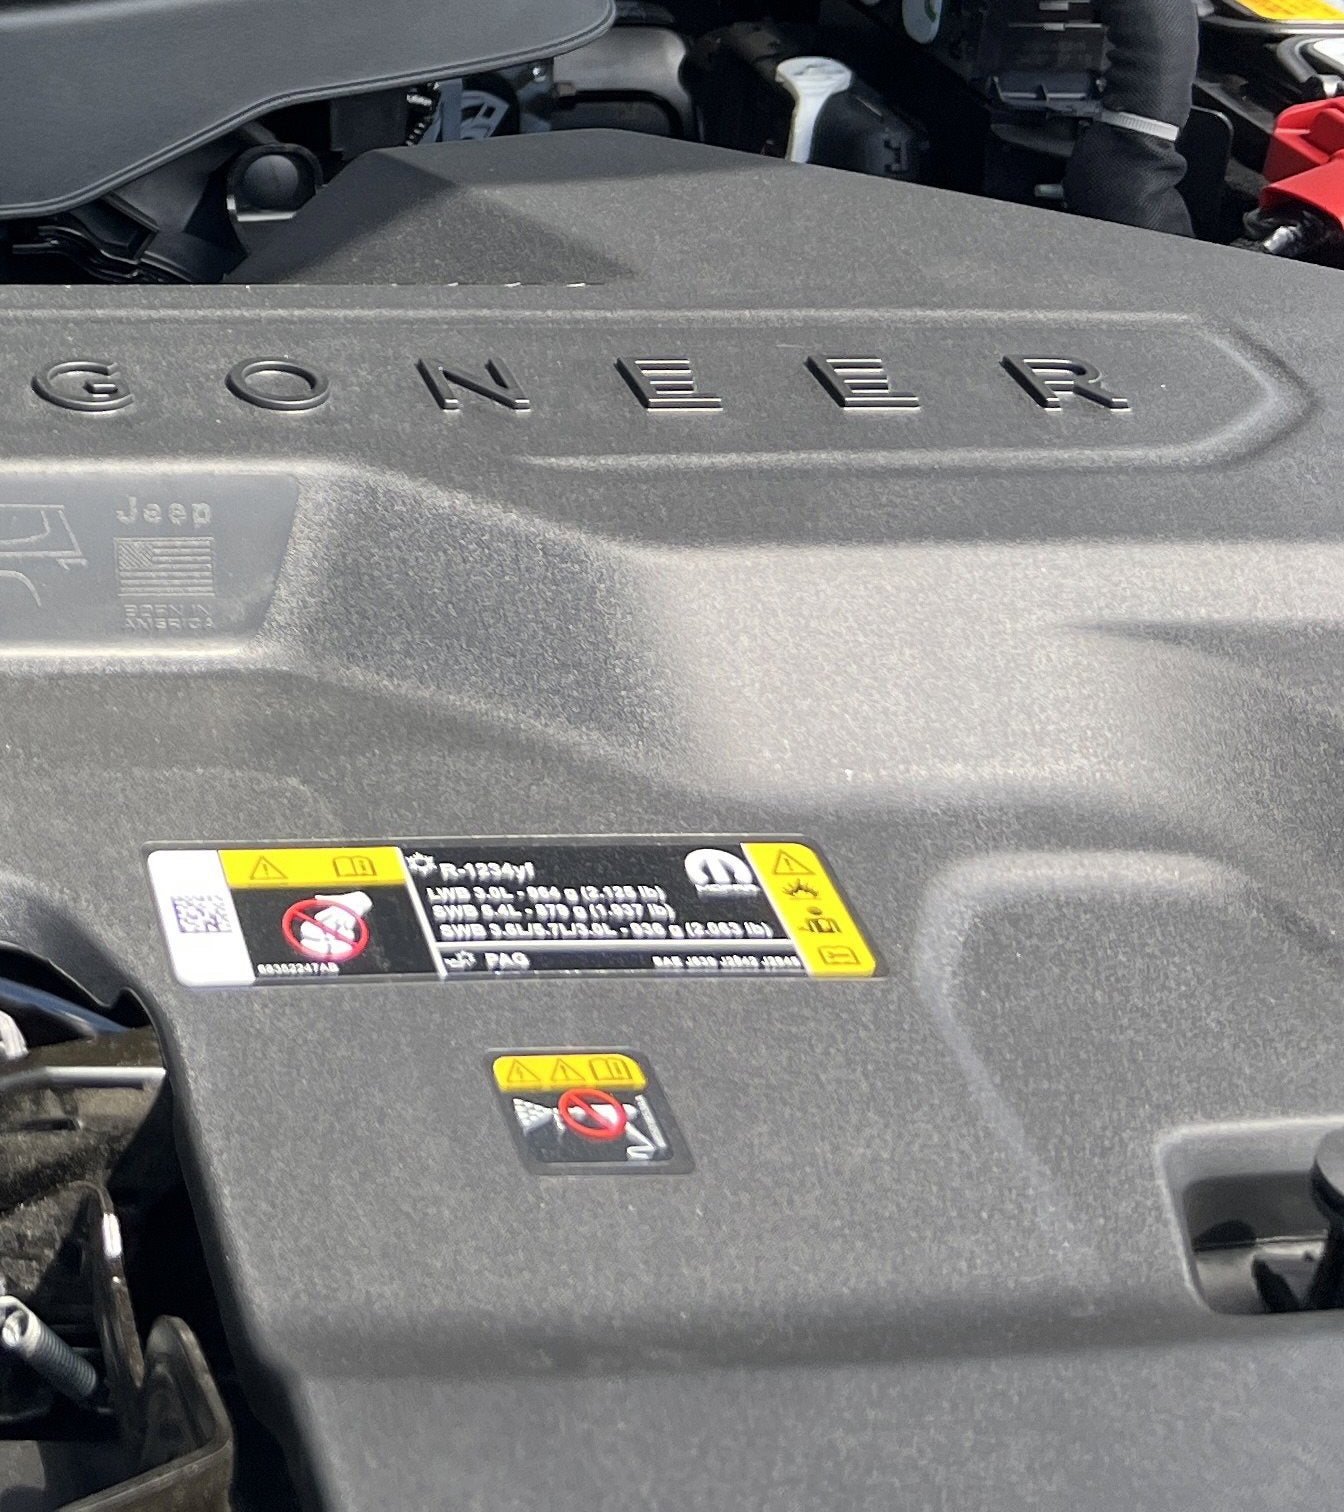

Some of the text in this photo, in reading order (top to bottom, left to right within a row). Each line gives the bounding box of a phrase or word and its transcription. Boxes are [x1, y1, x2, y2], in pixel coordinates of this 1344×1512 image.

[116, 494, 212, 529] Jeep
[439, 861, 535, 885] R-1234yf
[426, 886, 471, 904] LWB
